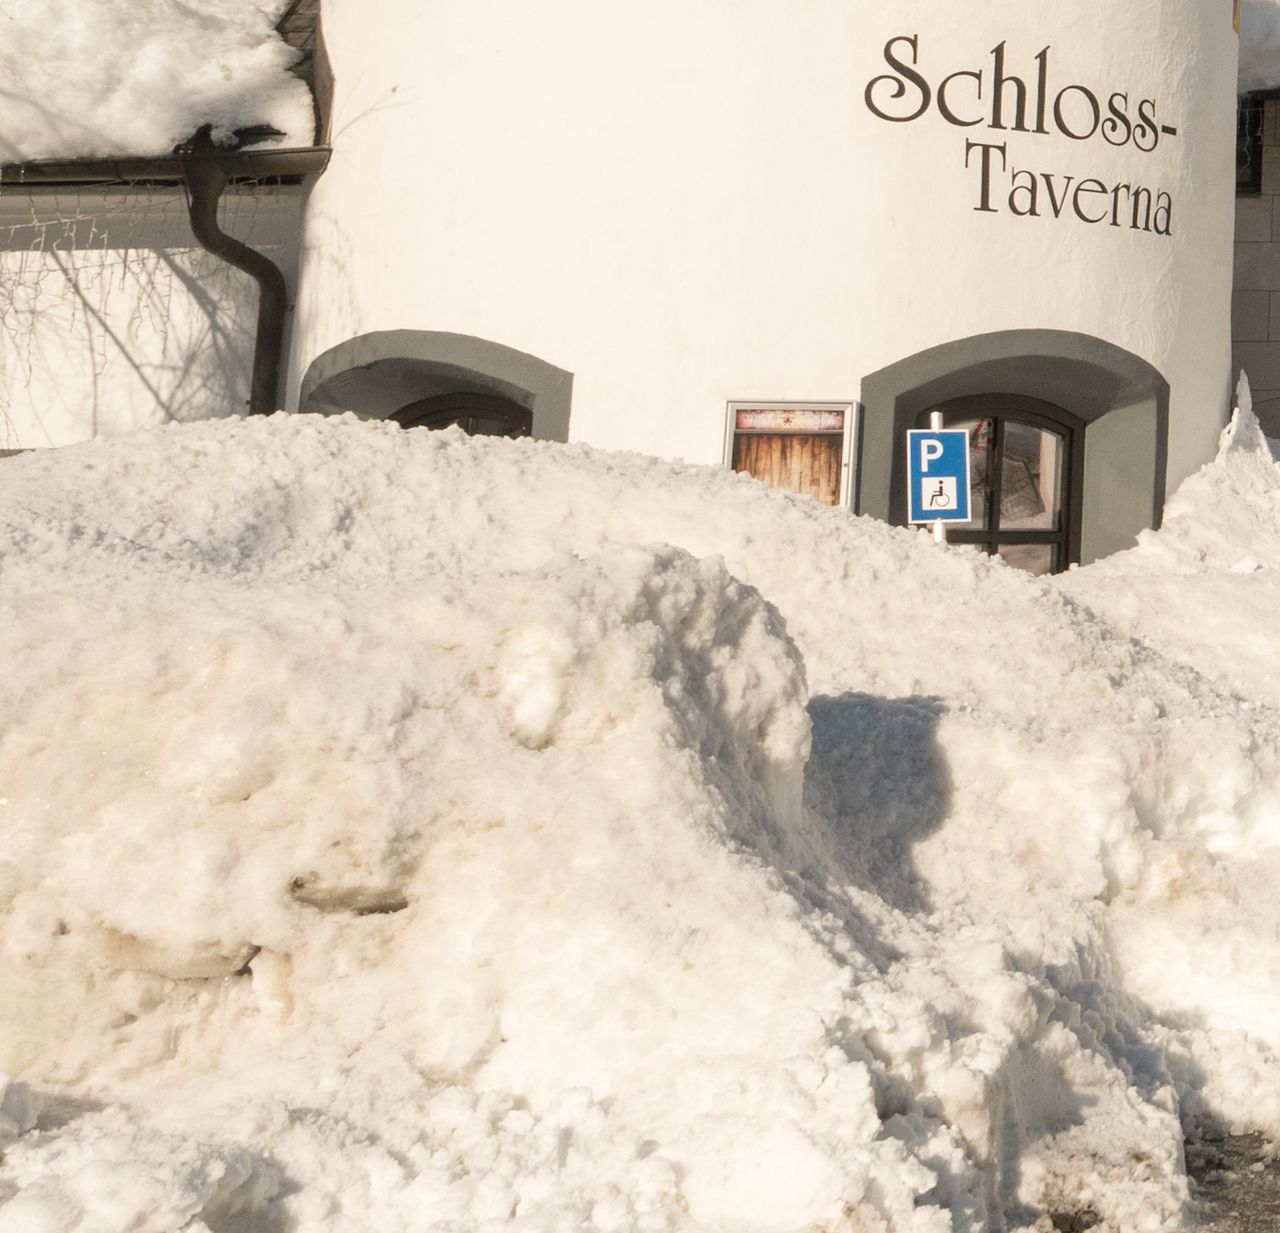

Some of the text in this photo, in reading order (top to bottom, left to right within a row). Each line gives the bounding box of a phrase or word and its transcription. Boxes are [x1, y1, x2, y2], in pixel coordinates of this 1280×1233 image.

[864, 33, 1178, 153] Schloss-
[964, 136, 1174, 237] Taverna
[920, 438, 944, 473] P
